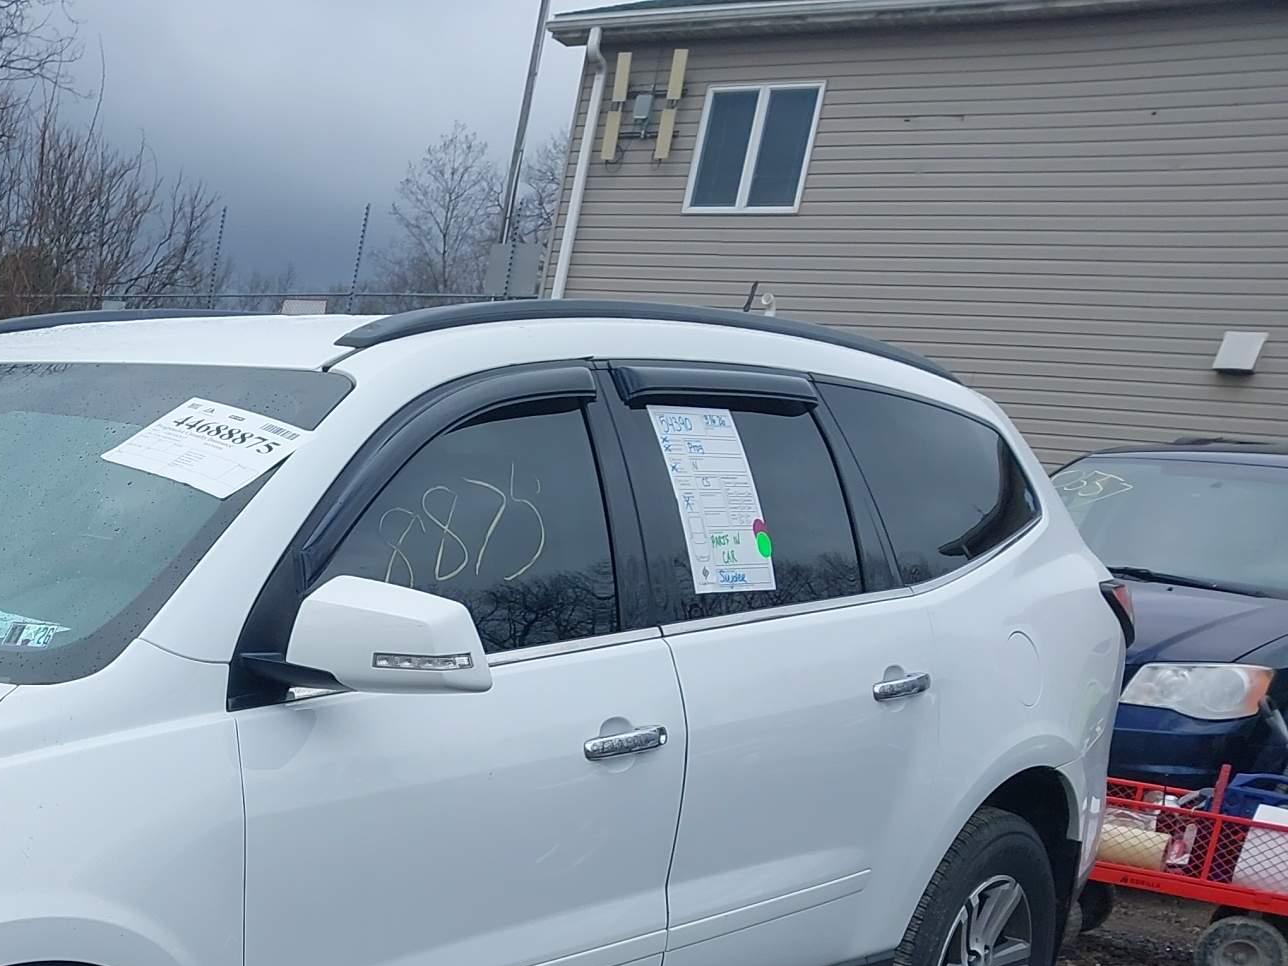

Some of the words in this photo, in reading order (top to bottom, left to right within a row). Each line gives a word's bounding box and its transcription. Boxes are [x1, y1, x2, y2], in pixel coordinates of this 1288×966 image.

[658, 415, 693, 433] 54390
[172, 415, 282, 455] 44688875
[711, 534, 729, 548] PARTS
[722, 550, 738, 563] CAR
